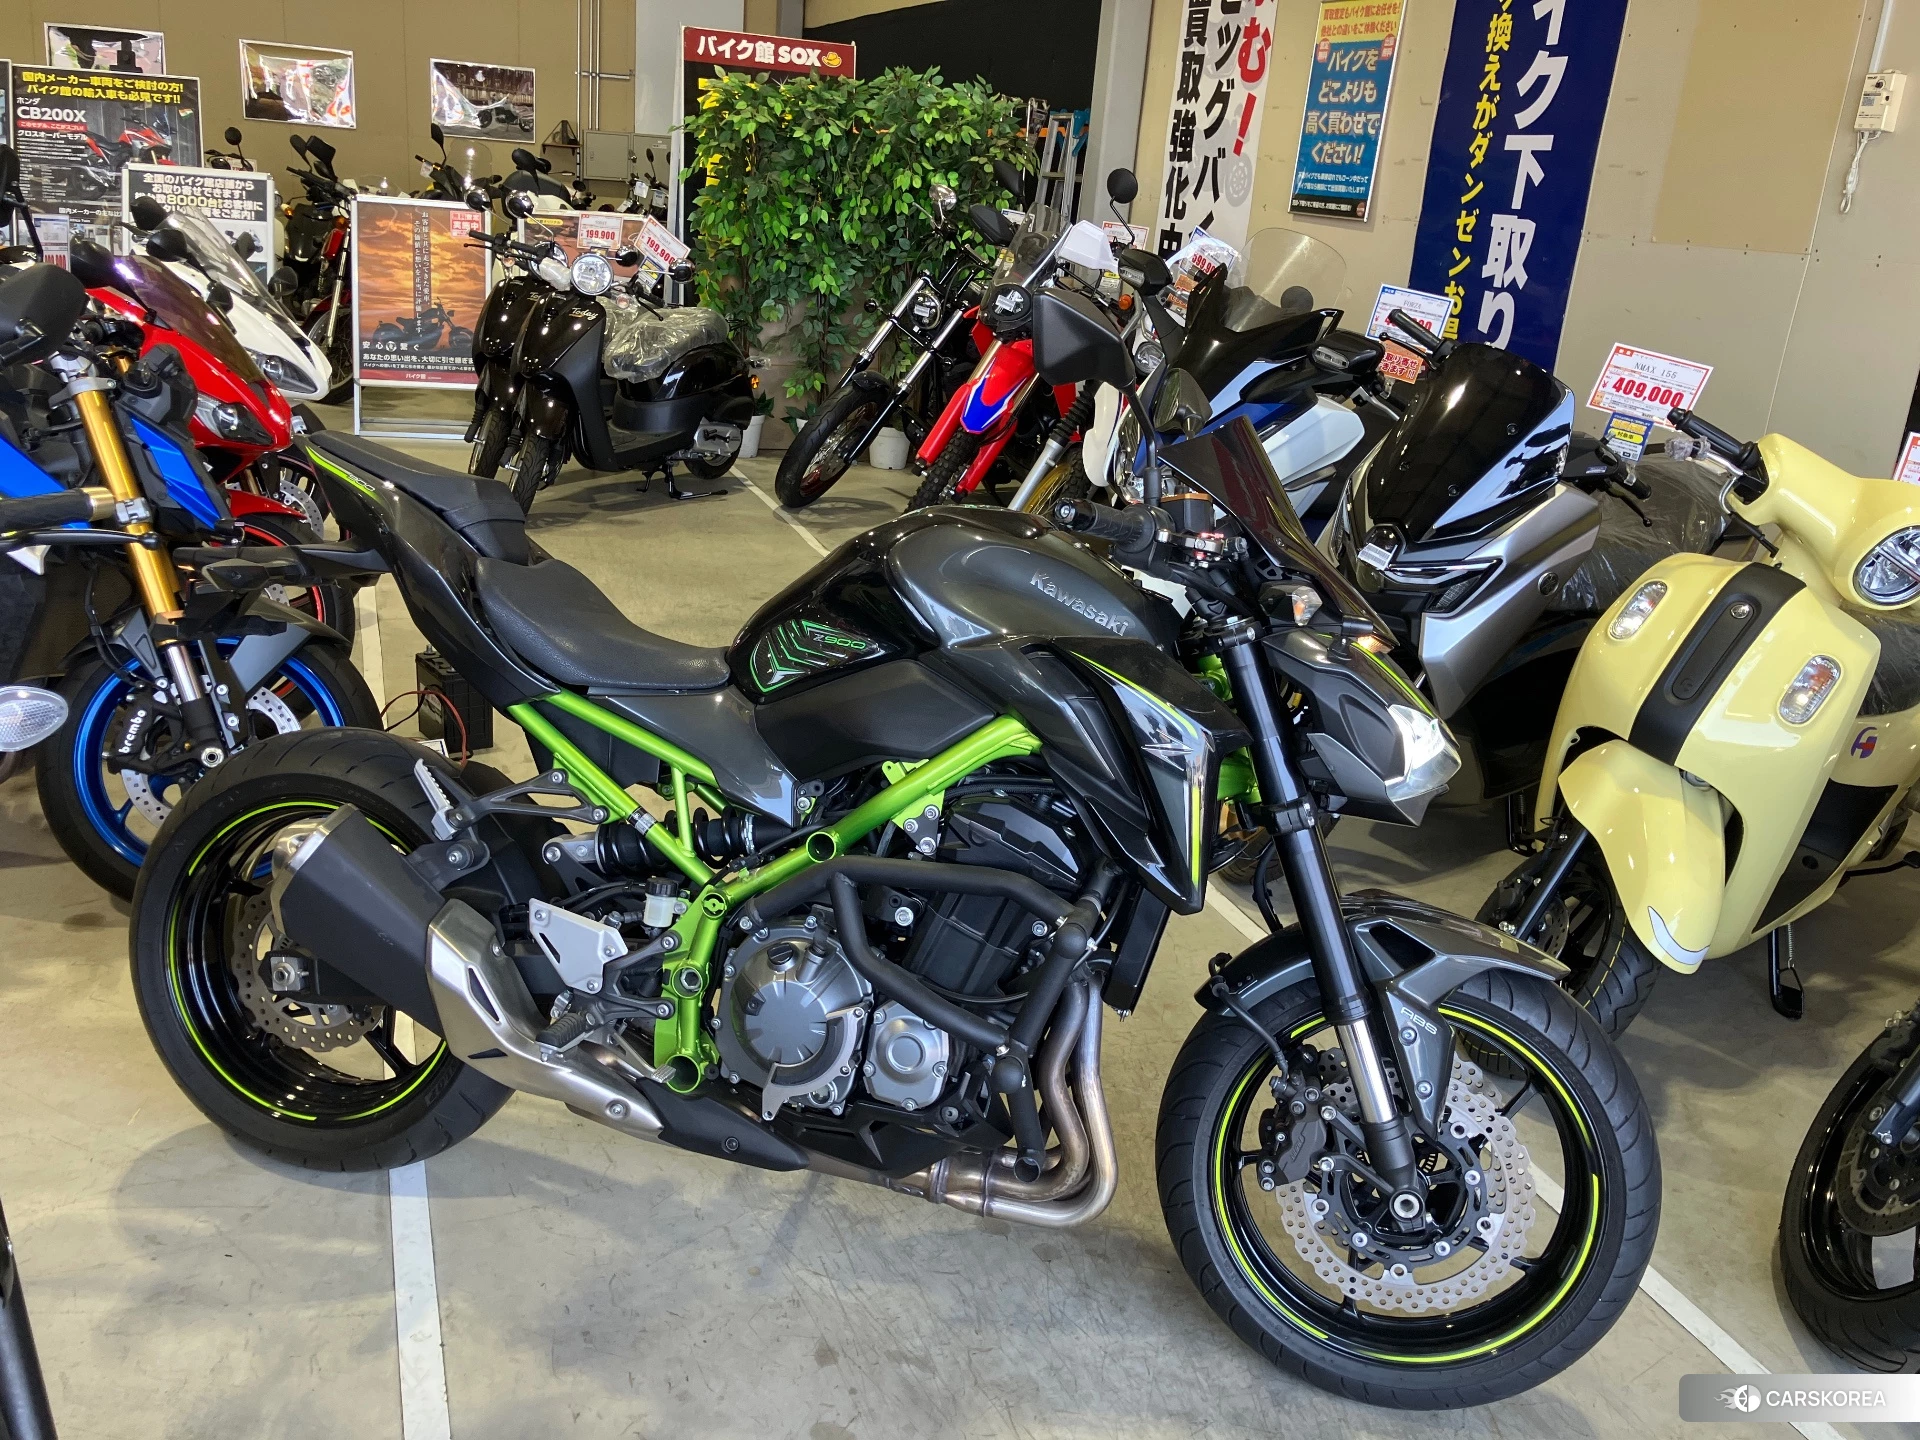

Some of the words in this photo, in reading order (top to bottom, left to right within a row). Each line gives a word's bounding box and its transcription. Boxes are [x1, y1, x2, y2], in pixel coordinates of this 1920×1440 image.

[697, 35, 775, 65] バイク館
[778, 45, 822, 67] SOX
[1327, 48, 1379, 72] バイクを
[22, 71, 184, 93] 国内メーカー車両をご検討の方!
[1233, 0, 1273, 156] む!
[17, 97, 41, 106] ホンダ
[27, 84, 181, 104] バイク館の輸入車も必見です!!
[1318, 80, 1377, 103] どこよりも
[17, 106, 87, 123] CB200X
[1189, 0, 1242, 237] ッグバ
[17, 130, 87, 141] クロスオーバーモデル
[1158, 0, 1211, 262] 買取強化中
[1311, 141, 1365, 164] ください!
[143, 172, 255, 190] 全国のバイク館店舗から
[1443, 0, 1513, 341] 換えがダンゼンお
[152, 183, 246, 200] お取り寄せできます!
[571, 307, 599, 321] Today
[1634, 361, 1657, 375] NMAX
[1661, 369, 1678, 380] 155
[1612, 376, 1685, 409] 409,000
[1030, 568, 1129, 637] Kawasaki
[813, 633, 866, 650] Z900
[118, 709, 147, 754] brembo
[1400, 1006, 1438, 1035] ABS
